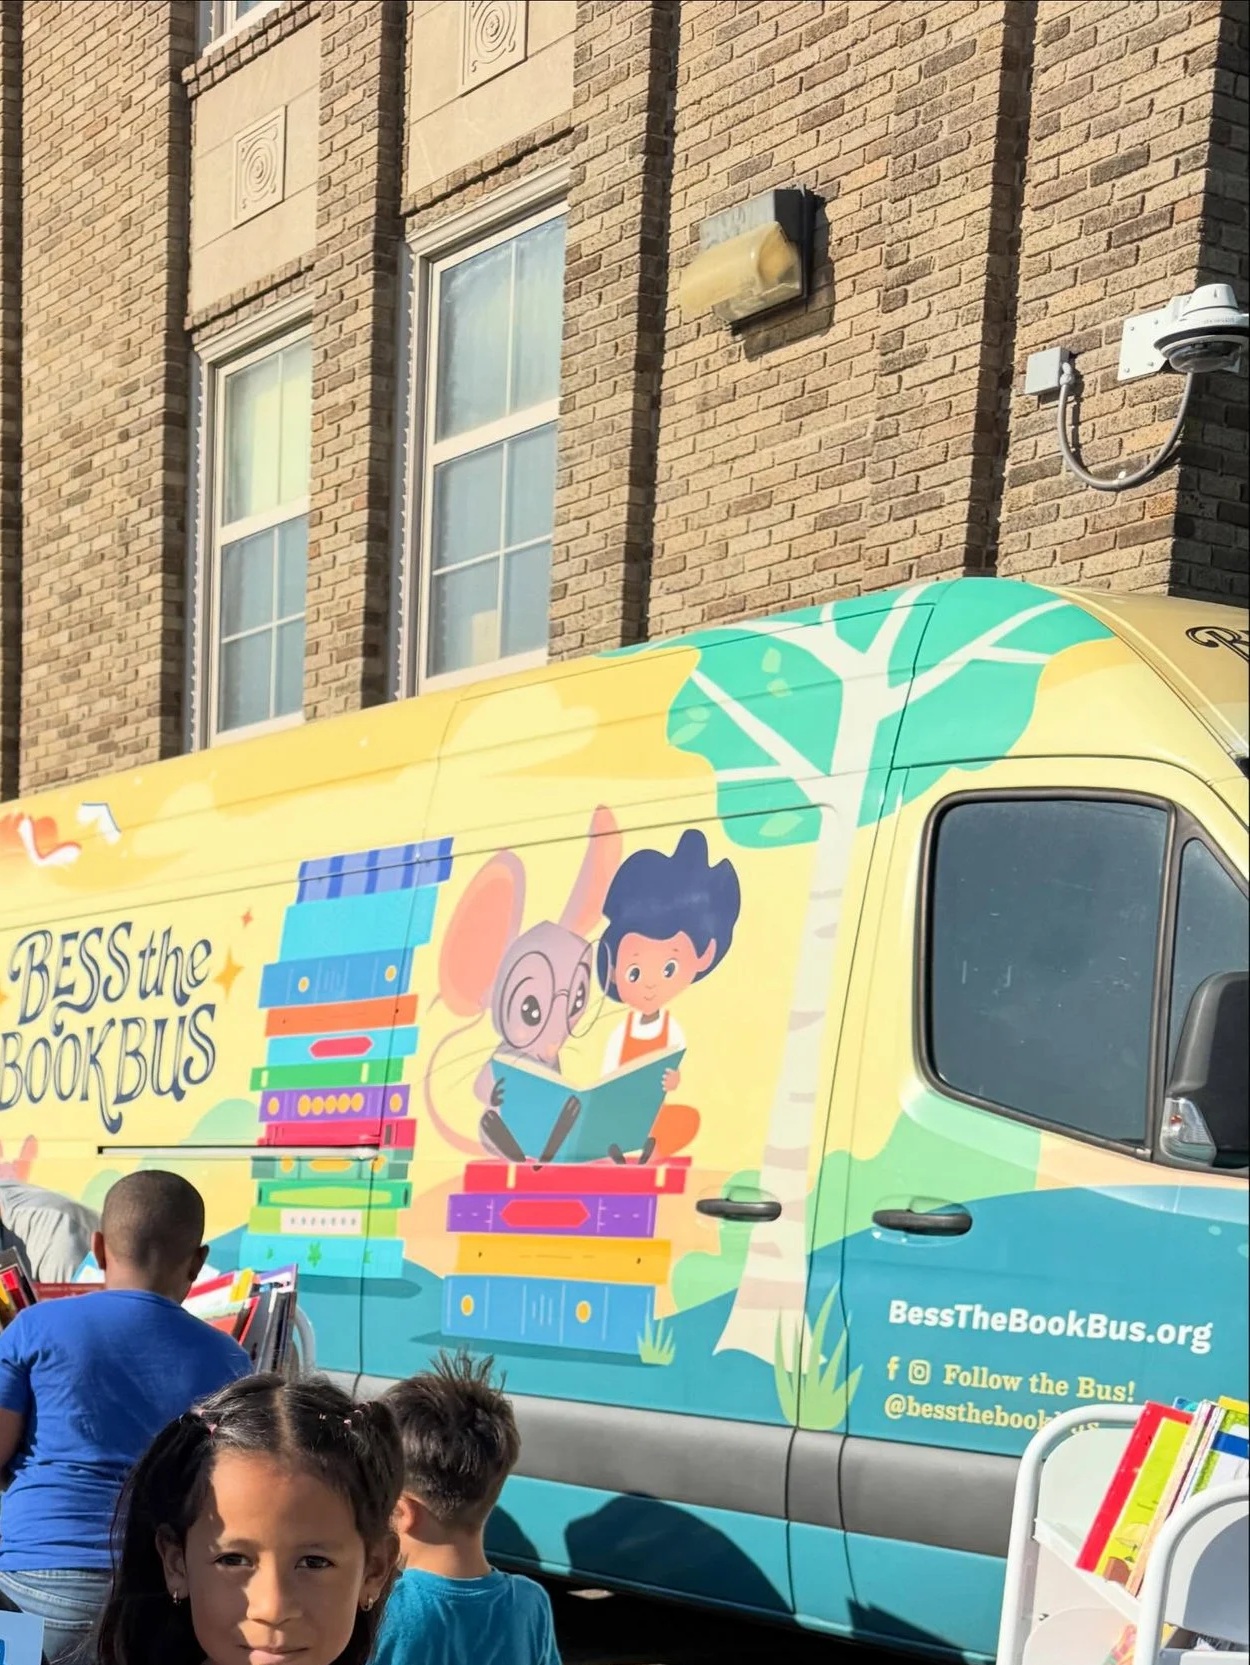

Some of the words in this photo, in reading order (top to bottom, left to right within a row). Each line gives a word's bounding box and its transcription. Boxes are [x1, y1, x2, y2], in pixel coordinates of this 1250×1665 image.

[8, 921, 133, 1037] BESS
[138, 926, 212, 1007] the
[888, 1300, 1214, 1354] BessTheBookBus.org
[943, 1363, 1022, 1392] Follow
[1029, 1372, 1069, 1396] the
[1076, 1375, 1136, 1402] Bus!
